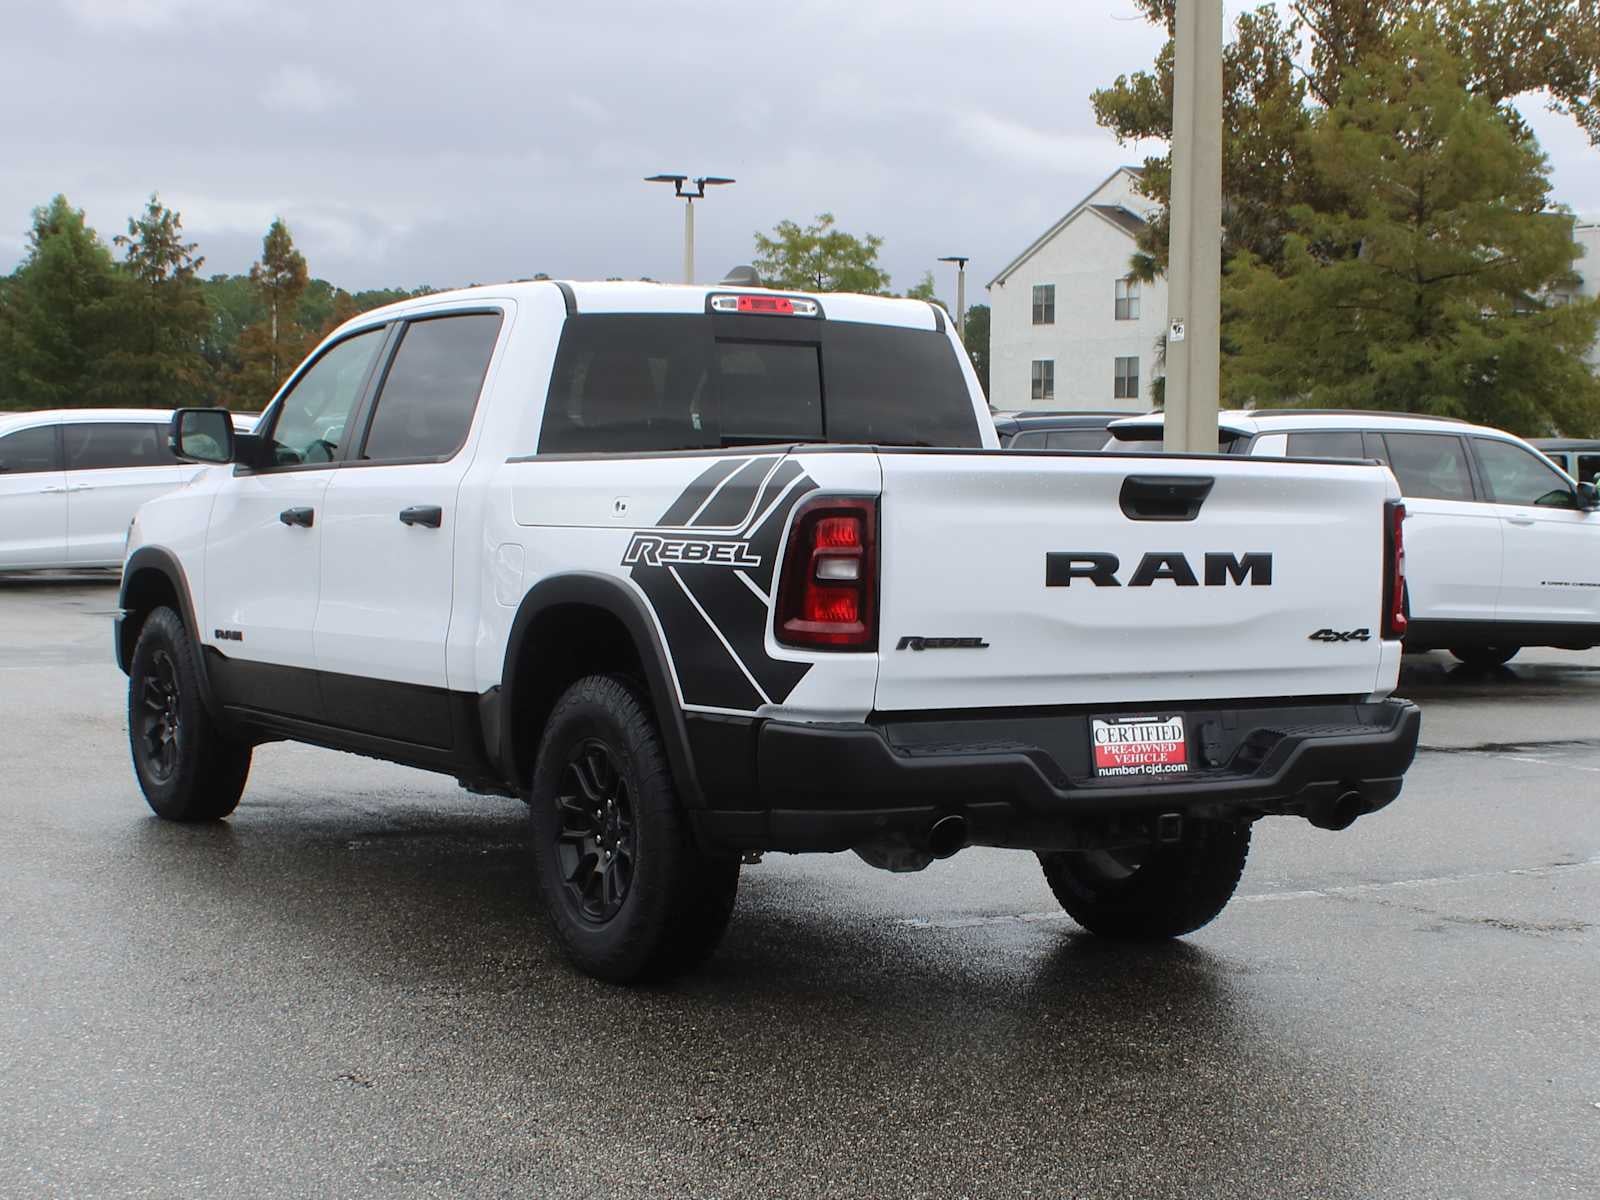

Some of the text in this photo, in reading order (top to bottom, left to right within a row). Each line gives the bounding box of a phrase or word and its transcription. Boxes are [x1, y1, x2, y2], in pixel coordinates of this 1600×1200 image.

[623, 535, 762, 567] REBEL
[1046, 552, 1273, 587] RAM
[1095, 725, 1182, 743] CERTIFIED
[1103, 743, 1177, 755] PRE-OWNED
[1115, 752, 1168, 764] VEHICLE
[1099, 763, 1188, 777] number1cjd.com
